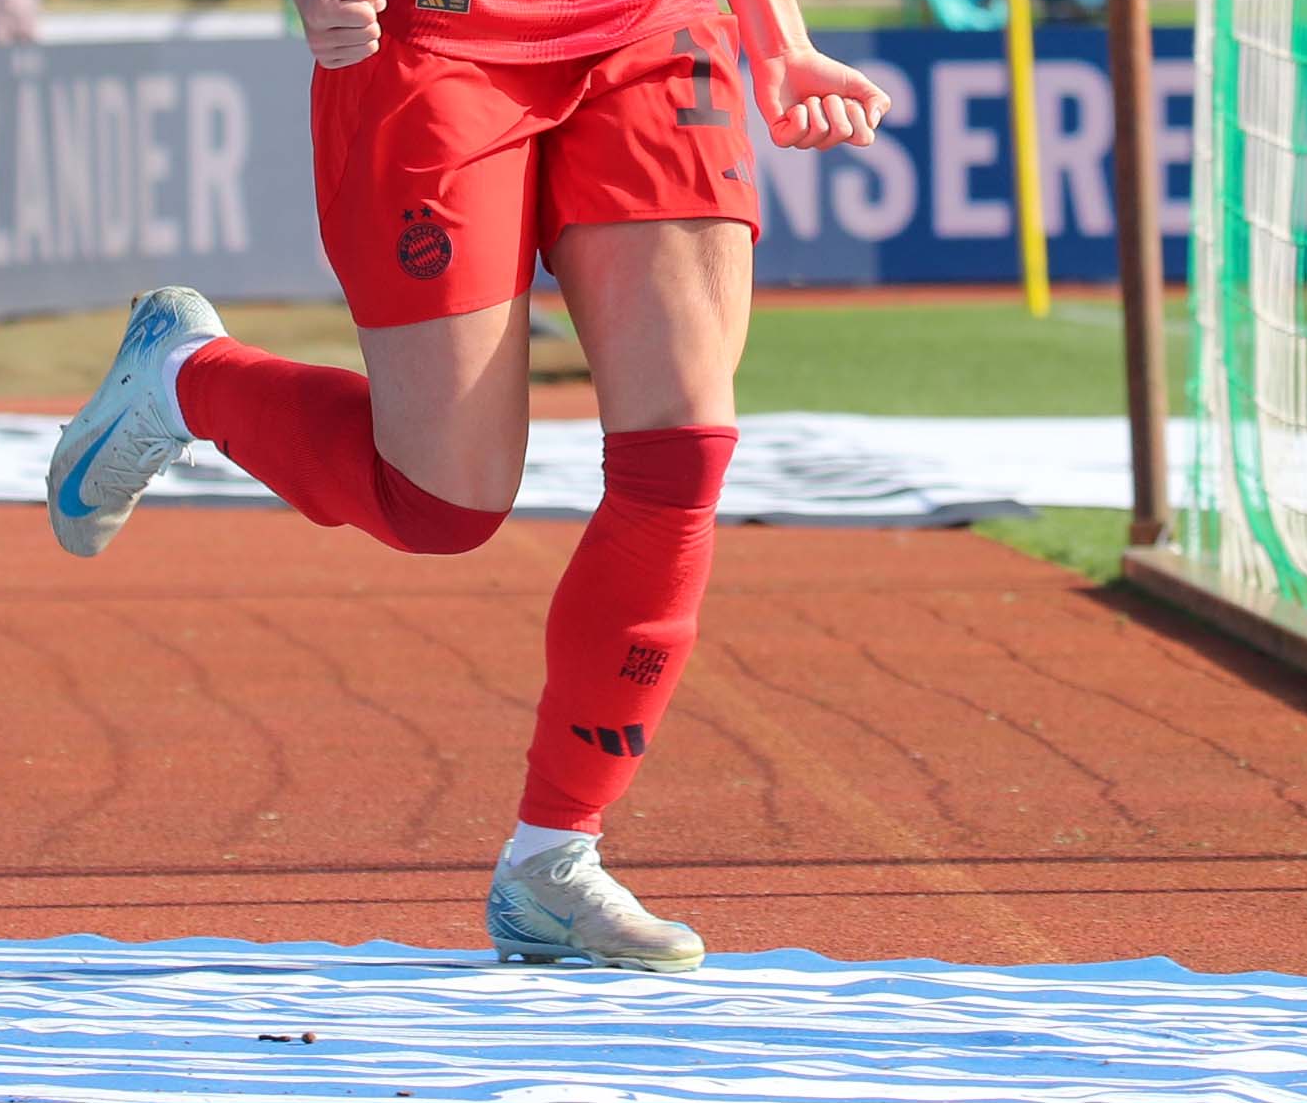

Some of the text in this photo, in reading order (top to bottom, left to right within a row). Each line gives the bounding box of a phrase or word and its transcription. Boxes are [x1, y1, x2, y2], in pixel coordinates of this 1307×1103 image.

[743, 57, 1199, 242] NSERE
[628, 644, 670, 663] MIA
[618, 666, 658, 686] MIA
